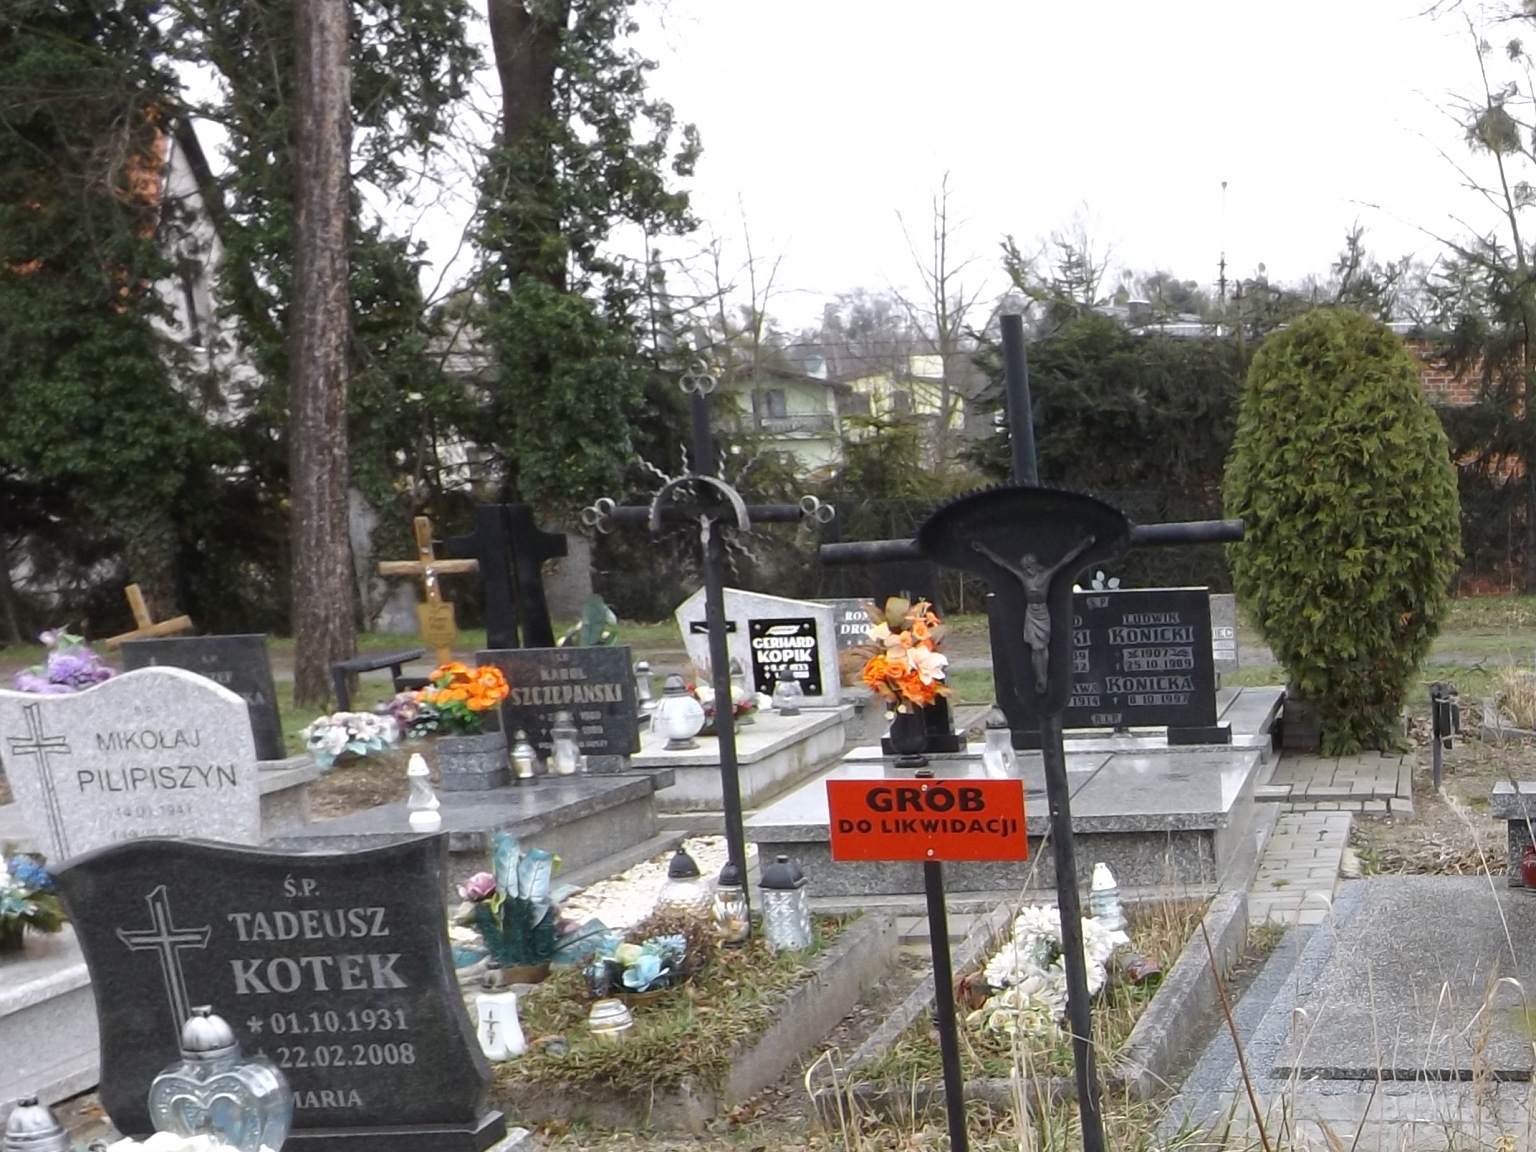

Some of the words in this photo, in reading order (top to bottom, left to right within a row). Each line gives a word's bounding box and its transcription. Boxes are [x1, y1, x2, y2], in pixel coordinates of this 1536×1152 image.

[752, 635, 816, 649] GERHARD
[1109, 627, 1194, 645] KONICKI
[757, 648, 813, 663] KOPIK
[1106, 676, 1195, 694] KONICKA
[96, 729, 201, 752] MIKOŁAJ
[77, 765, 238, 793] PILIPISZYN
[866, 780, 986, 813] GRÓB
[838, 818, 872, 834] DO
[881, 818, 1018, 838] LIKWIDACJI
[227, 906, 390, 942] TADEUSZ
[230, 953, 408, 995] KOTEK
[270, 1008, 410, 1035] 01.10.1931
[277, 1043, 416, 1069] 22.02.2008
